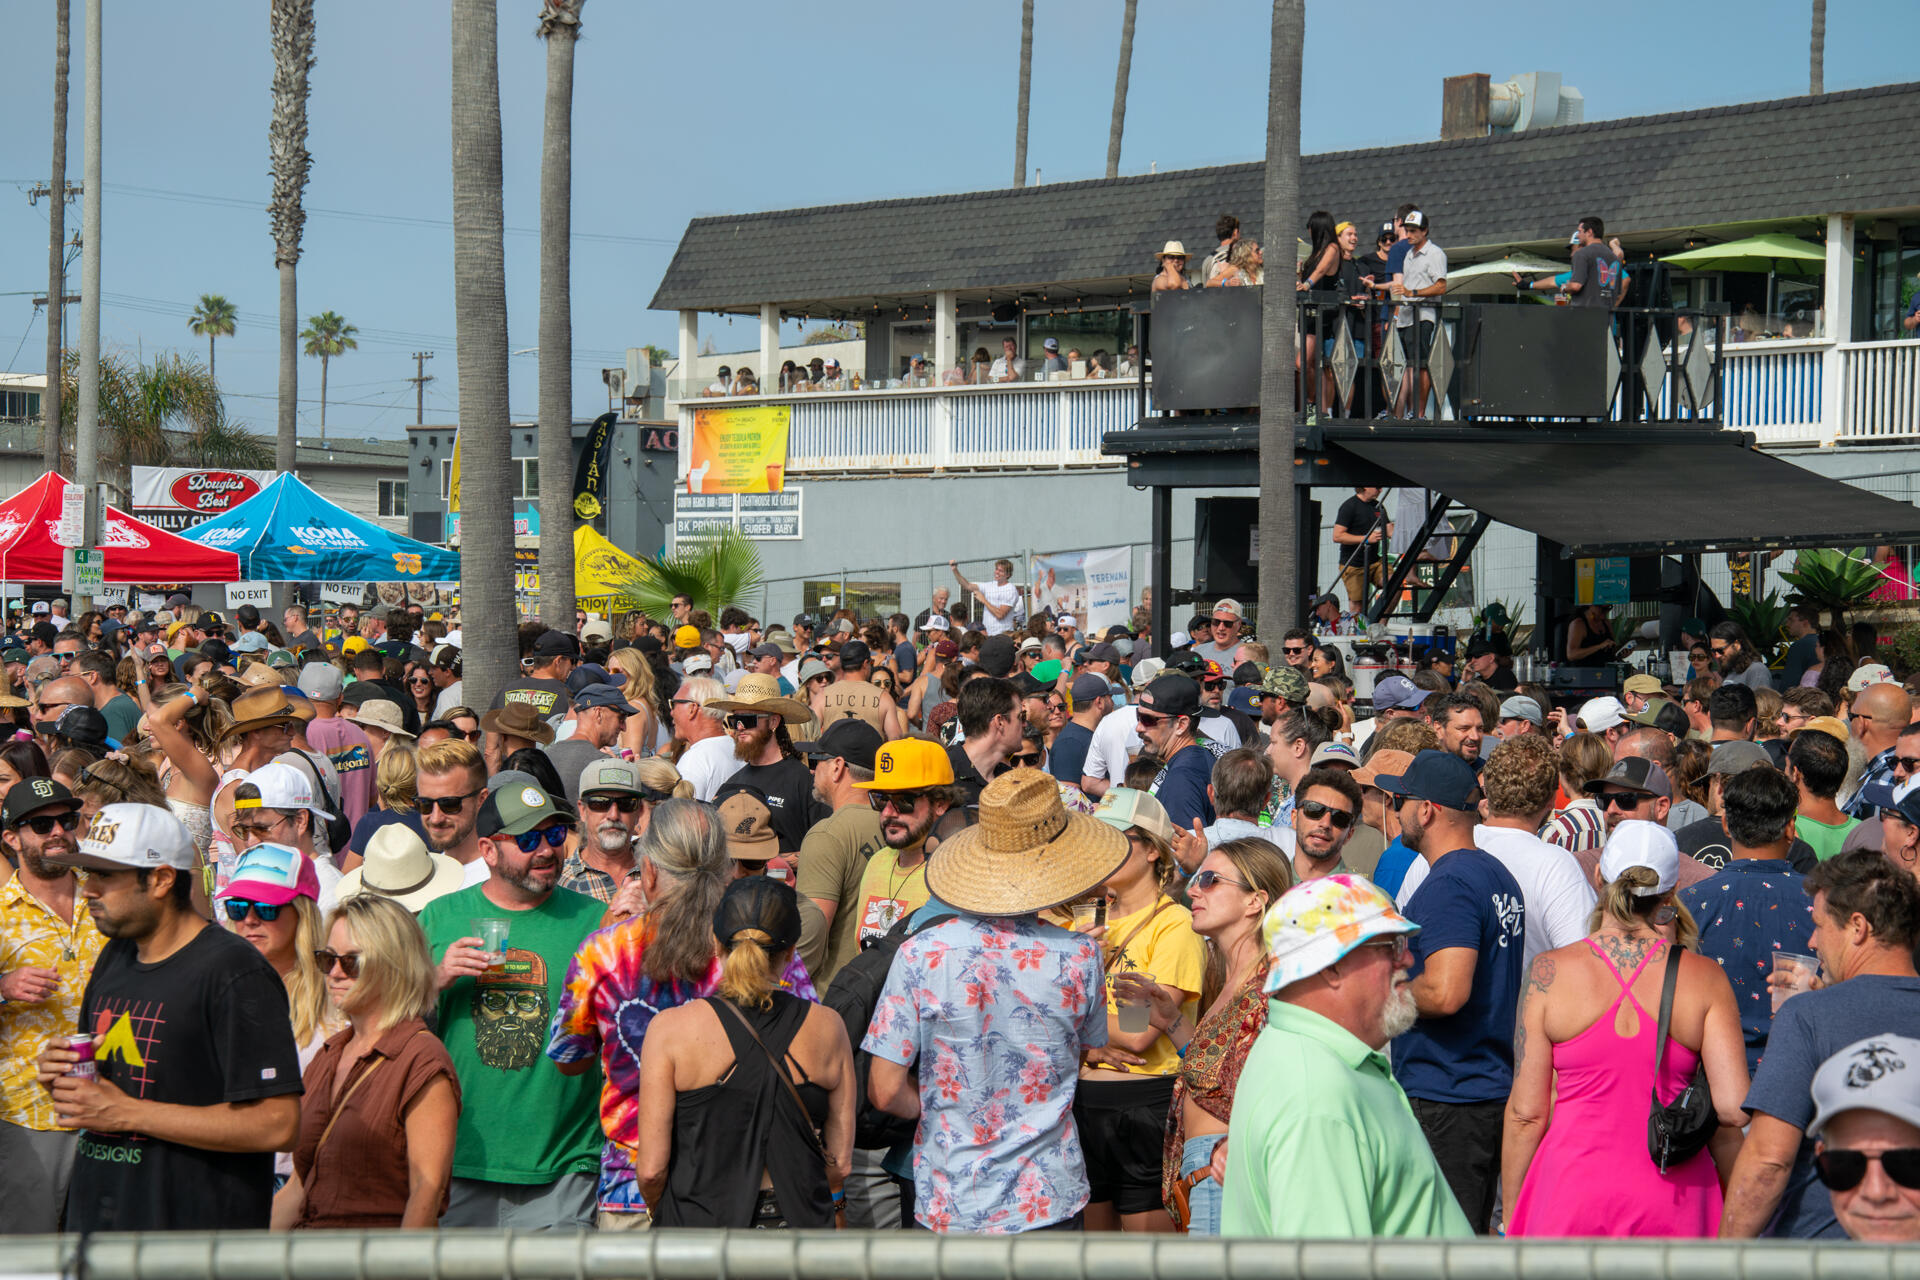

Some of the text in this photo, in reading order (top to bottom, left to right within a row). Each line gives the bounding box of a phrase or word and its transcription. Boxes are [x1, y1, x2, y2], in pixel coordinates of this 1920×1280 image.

[188, 474, 245, 494] Dougie's
[196, 492, 231, 508] Best
[692, 496, 706, 508] BEACH
[740, 494, 798, 506] LIGHTHOUSE ICE CREAM
[138, 514, 219, 529] PHILLY CH
[678, 519, 731, 532] BK PRINTING
[198, 527, 250, 540] KONA
[289, 526, 361, 540] KONA
[744, 523, 793, 534] SURFER BABY
[300, 538, 371, 547] BIG WAVE
[78, 551, 84, 563] 4
[76, 566, 102, 576] PARKING
[1090, 571, 1128, 583] TEREMANA
[103, 587, 125, 598] EXIT
[230, 589, 268, 600] NO EXIT
[325, 583, 361, 596] NO EXIT
[824, 694, 880, 709] LUCID
[88, 822, 121, 845] RES
